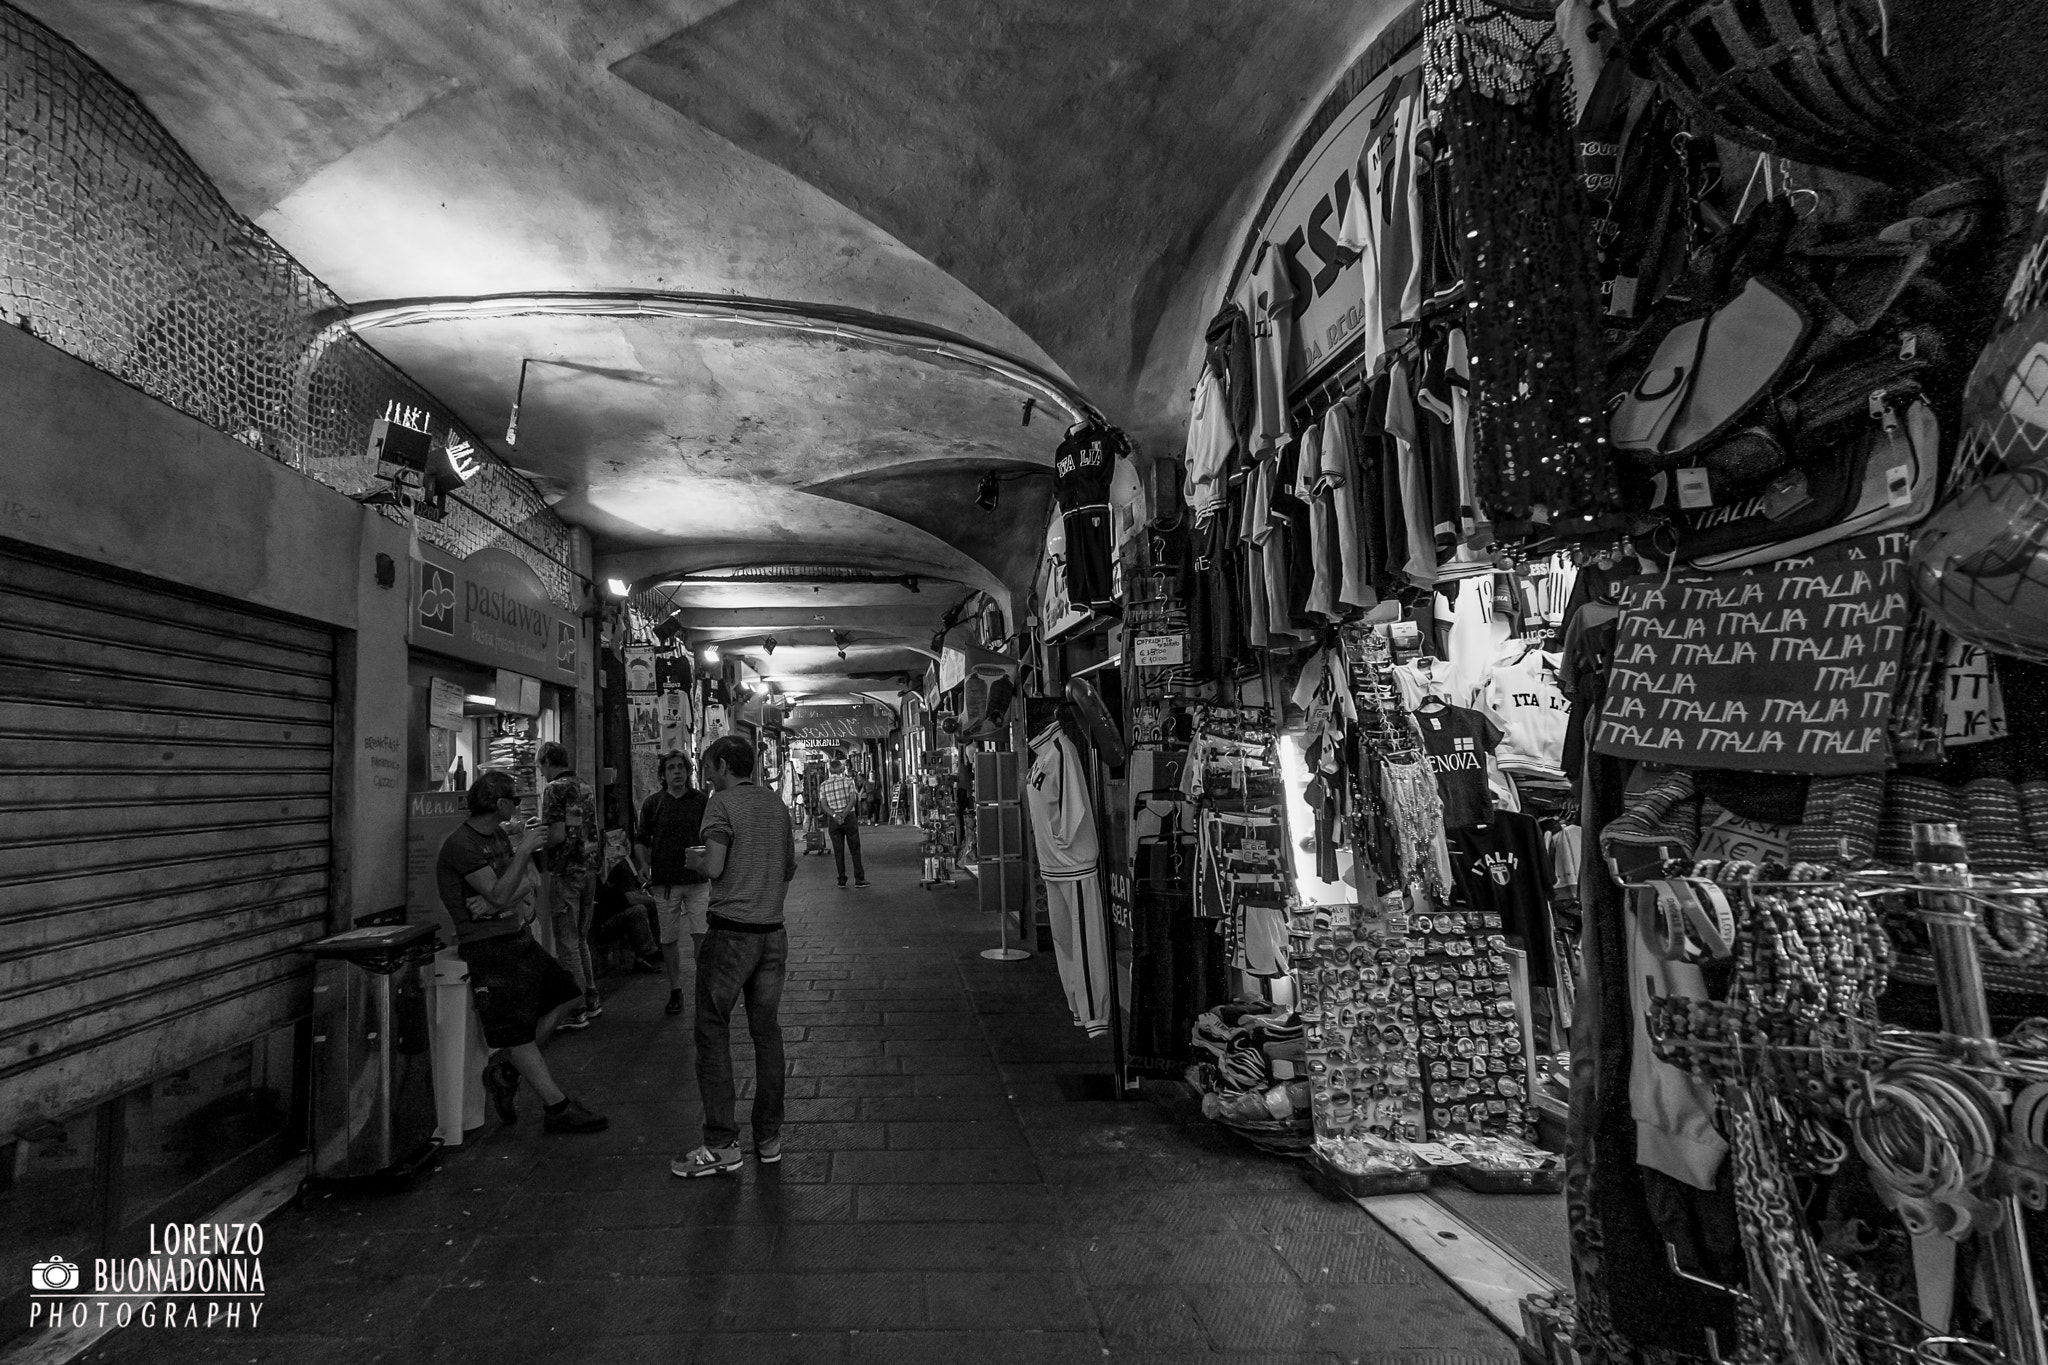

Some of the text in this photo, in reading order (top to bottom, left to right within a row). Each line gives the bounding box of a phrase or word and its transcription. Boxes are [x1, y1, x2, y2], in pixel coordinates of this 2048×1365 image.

[1695, 494, 1766, 531] ITALIA
[1528, 562, 1550, 577] ESSI
[1680, 583, 1764, 611] ITALIA
[1777, 569, 1871, 600] ITALIA
[463, 579, 552, 649] pastaway
[1622, 591, 1906, 640] ITALIA ITALIA ITALIA
[1670, 640, 1758, 666] ITALIA
[1769, 633, 1866, 662] ITALIA
[1607, 667, 1697, 695] ITALIA
[1658, 697, 1748, 724] ITALIA
[1759, 697, 1850, 723] ITALIA
[1595, 719, 1685, 750] ITALIA
[1695, 727, 1785, 754] ITALIA
[1429, 751, 1482, 774] ENOVA
[411, 798, 455, 817] Menu
[1112, 903, 1128, 929] SELF
